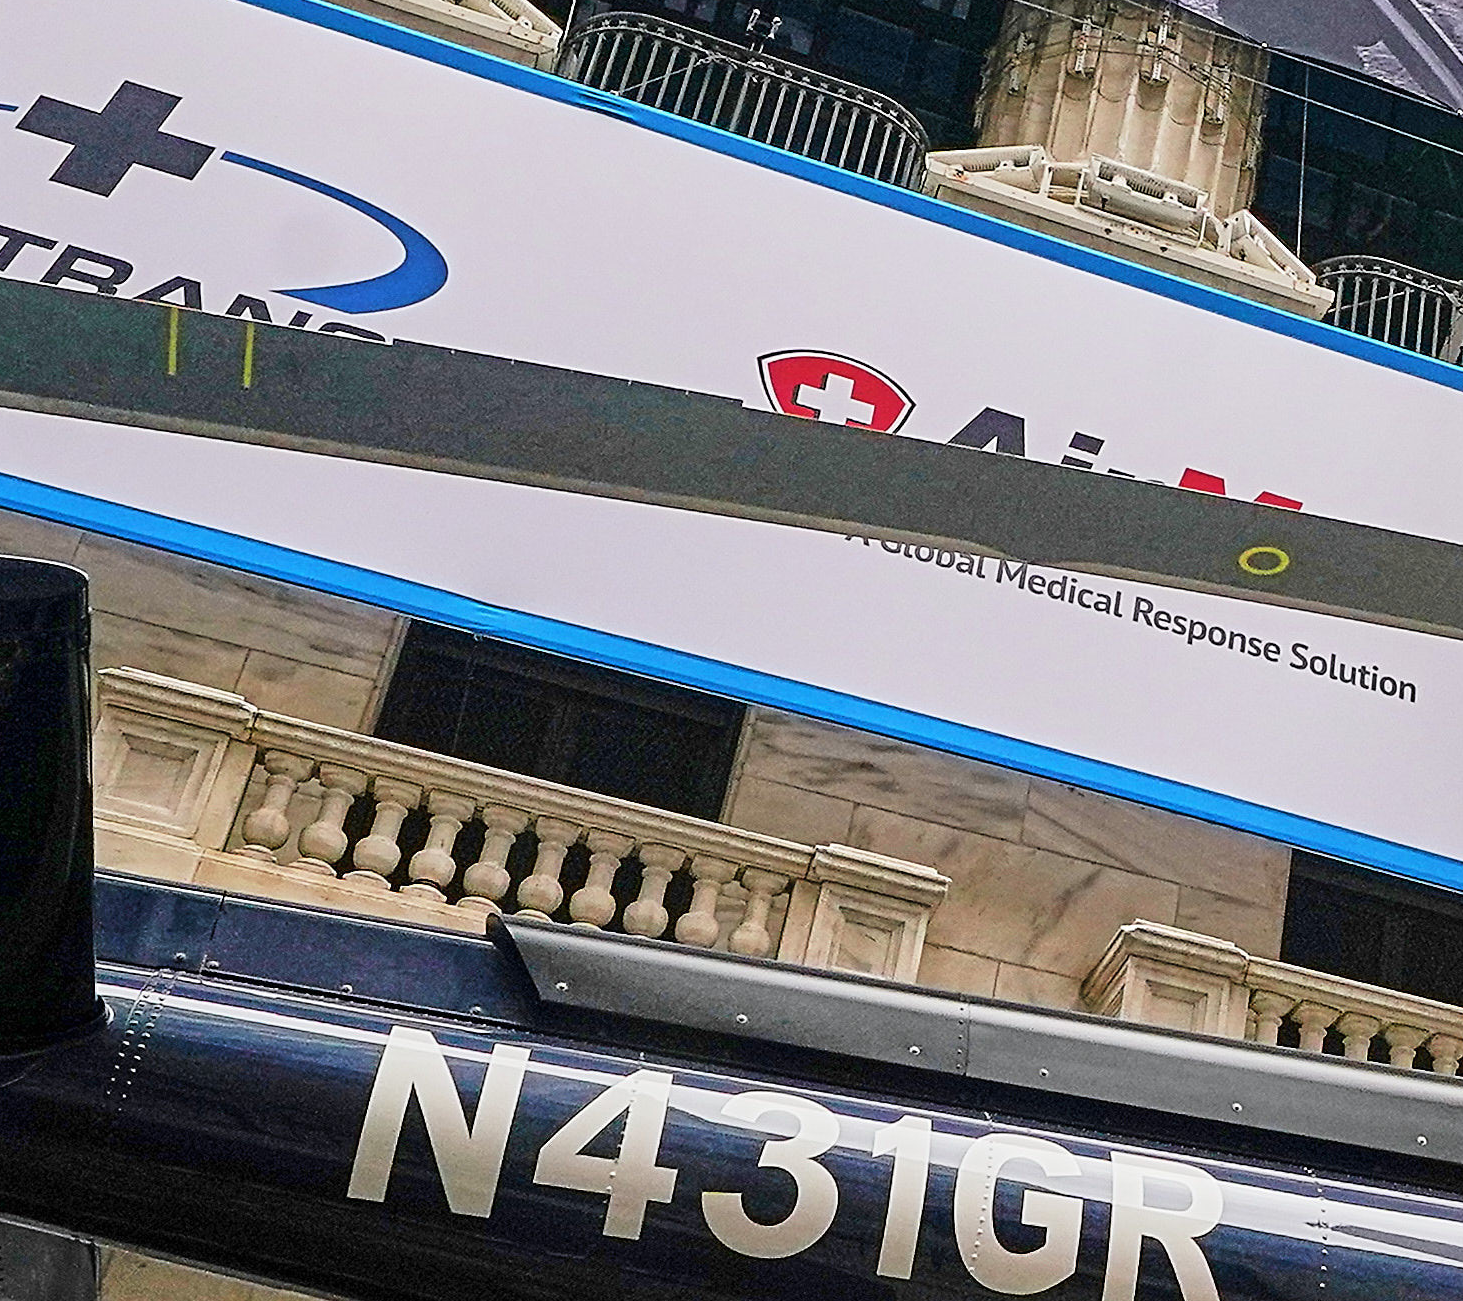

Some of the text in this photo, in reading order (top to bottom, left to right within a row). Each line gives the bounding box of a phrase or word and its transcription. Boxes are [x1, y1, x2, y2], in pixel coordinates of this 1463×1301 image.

[995, 559, 1123, 618] Medical
[1132, 596, 1282, 664] Response
[1289, 641, 1420, 704] Solution
